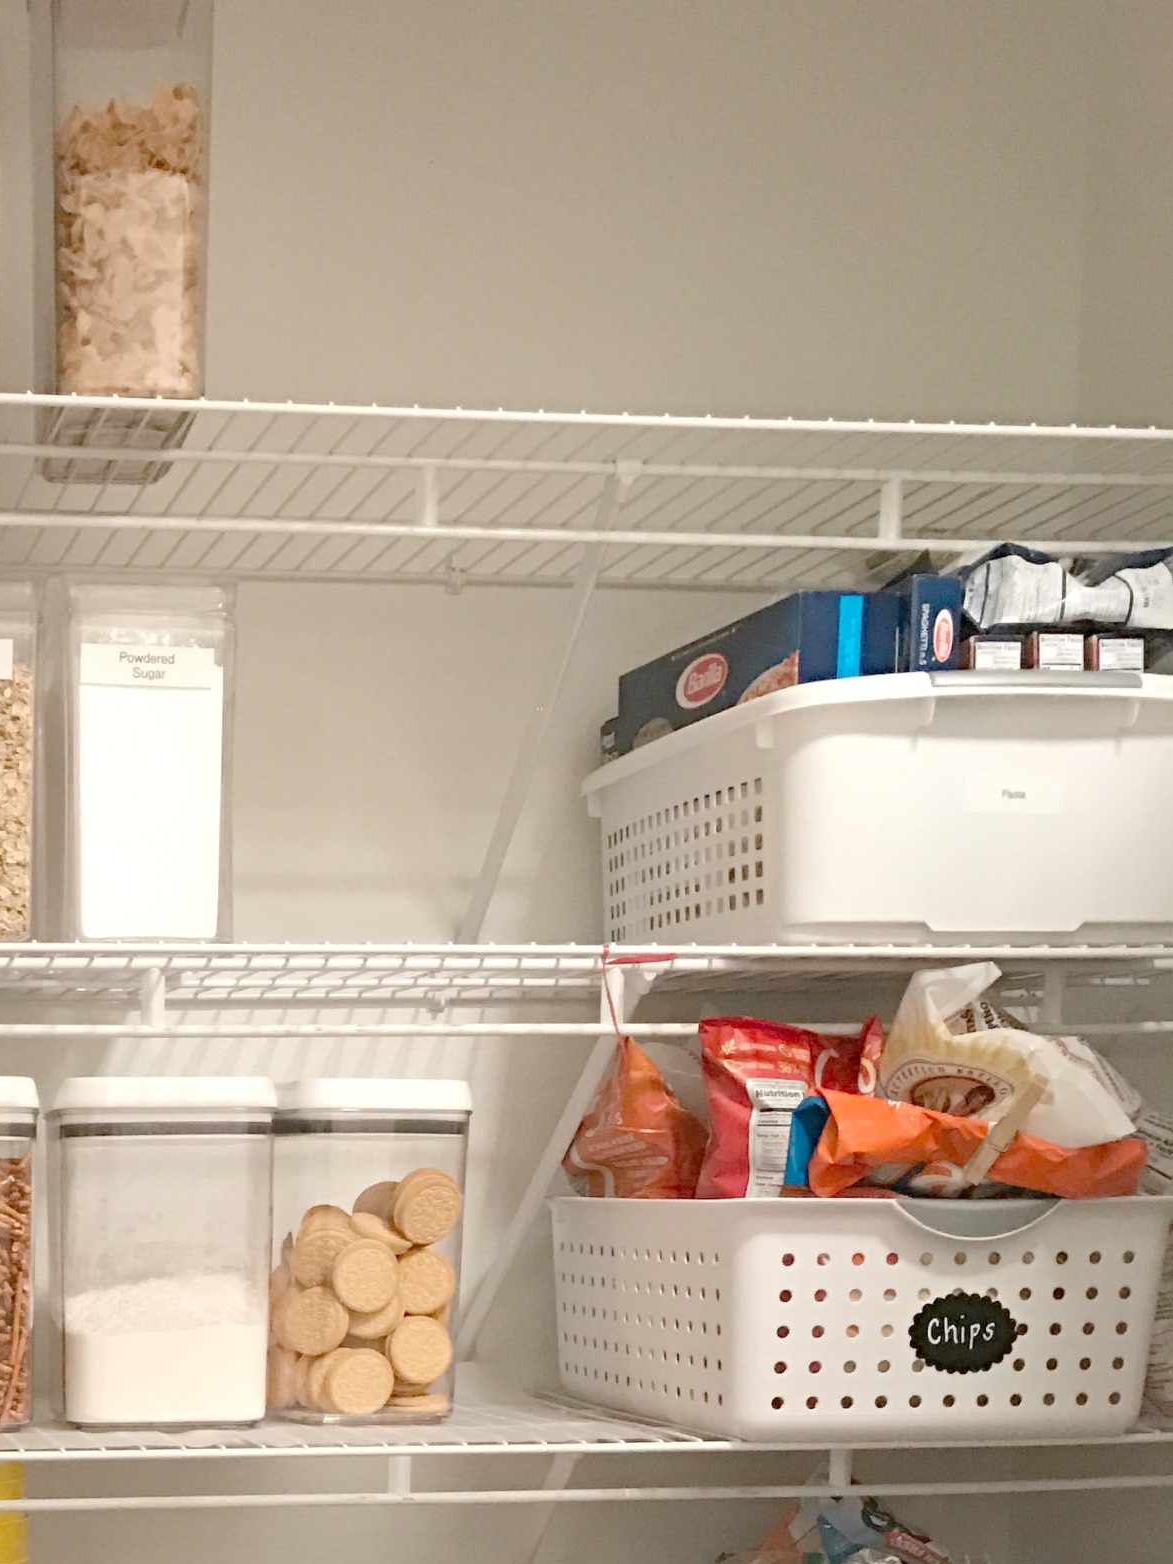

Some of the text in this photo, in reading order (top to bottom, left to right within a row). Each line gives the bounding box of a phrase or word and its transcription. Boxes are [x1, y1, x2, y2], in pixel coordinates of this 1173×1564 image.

[920, 603, 930, 651] SPAGHETTI
[119, 651, 175, 665] Powdered
[132, 667, 166, 682] Sugar
[755, 1089, 801, 1099] Nutrition
[926, 1315, 996, 1347] Chips
